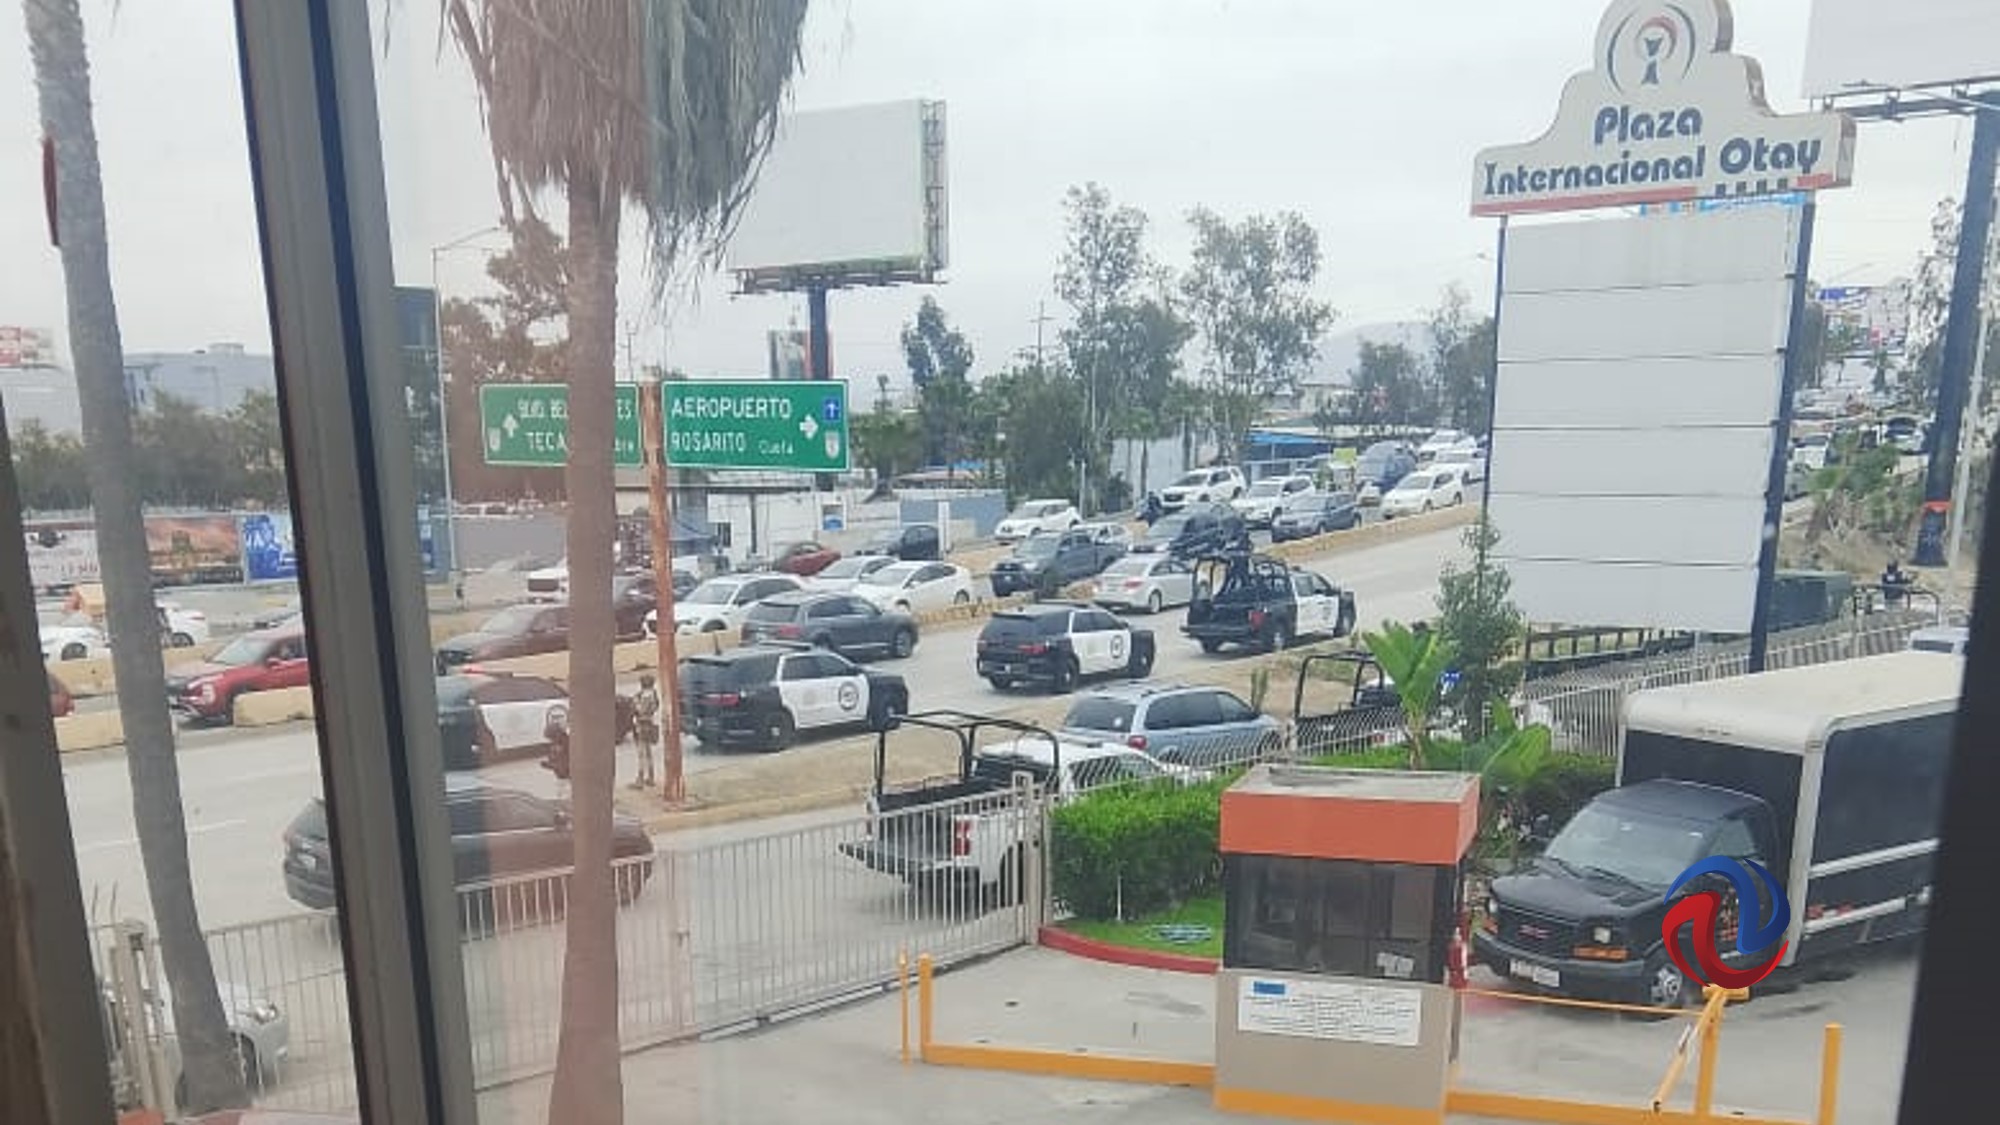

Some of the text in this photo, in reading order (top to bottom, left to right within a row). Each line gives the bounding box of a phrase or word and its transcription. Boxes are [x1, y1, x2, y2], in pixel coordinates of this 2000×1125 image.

[1594, 105, 1702, 145] Plaza
[1484, 137, 1822, 196] Internacional Otay
[671, 397, 792, 419] AEROPUERTO
[671, 431, 746, 452] ROSARITO
